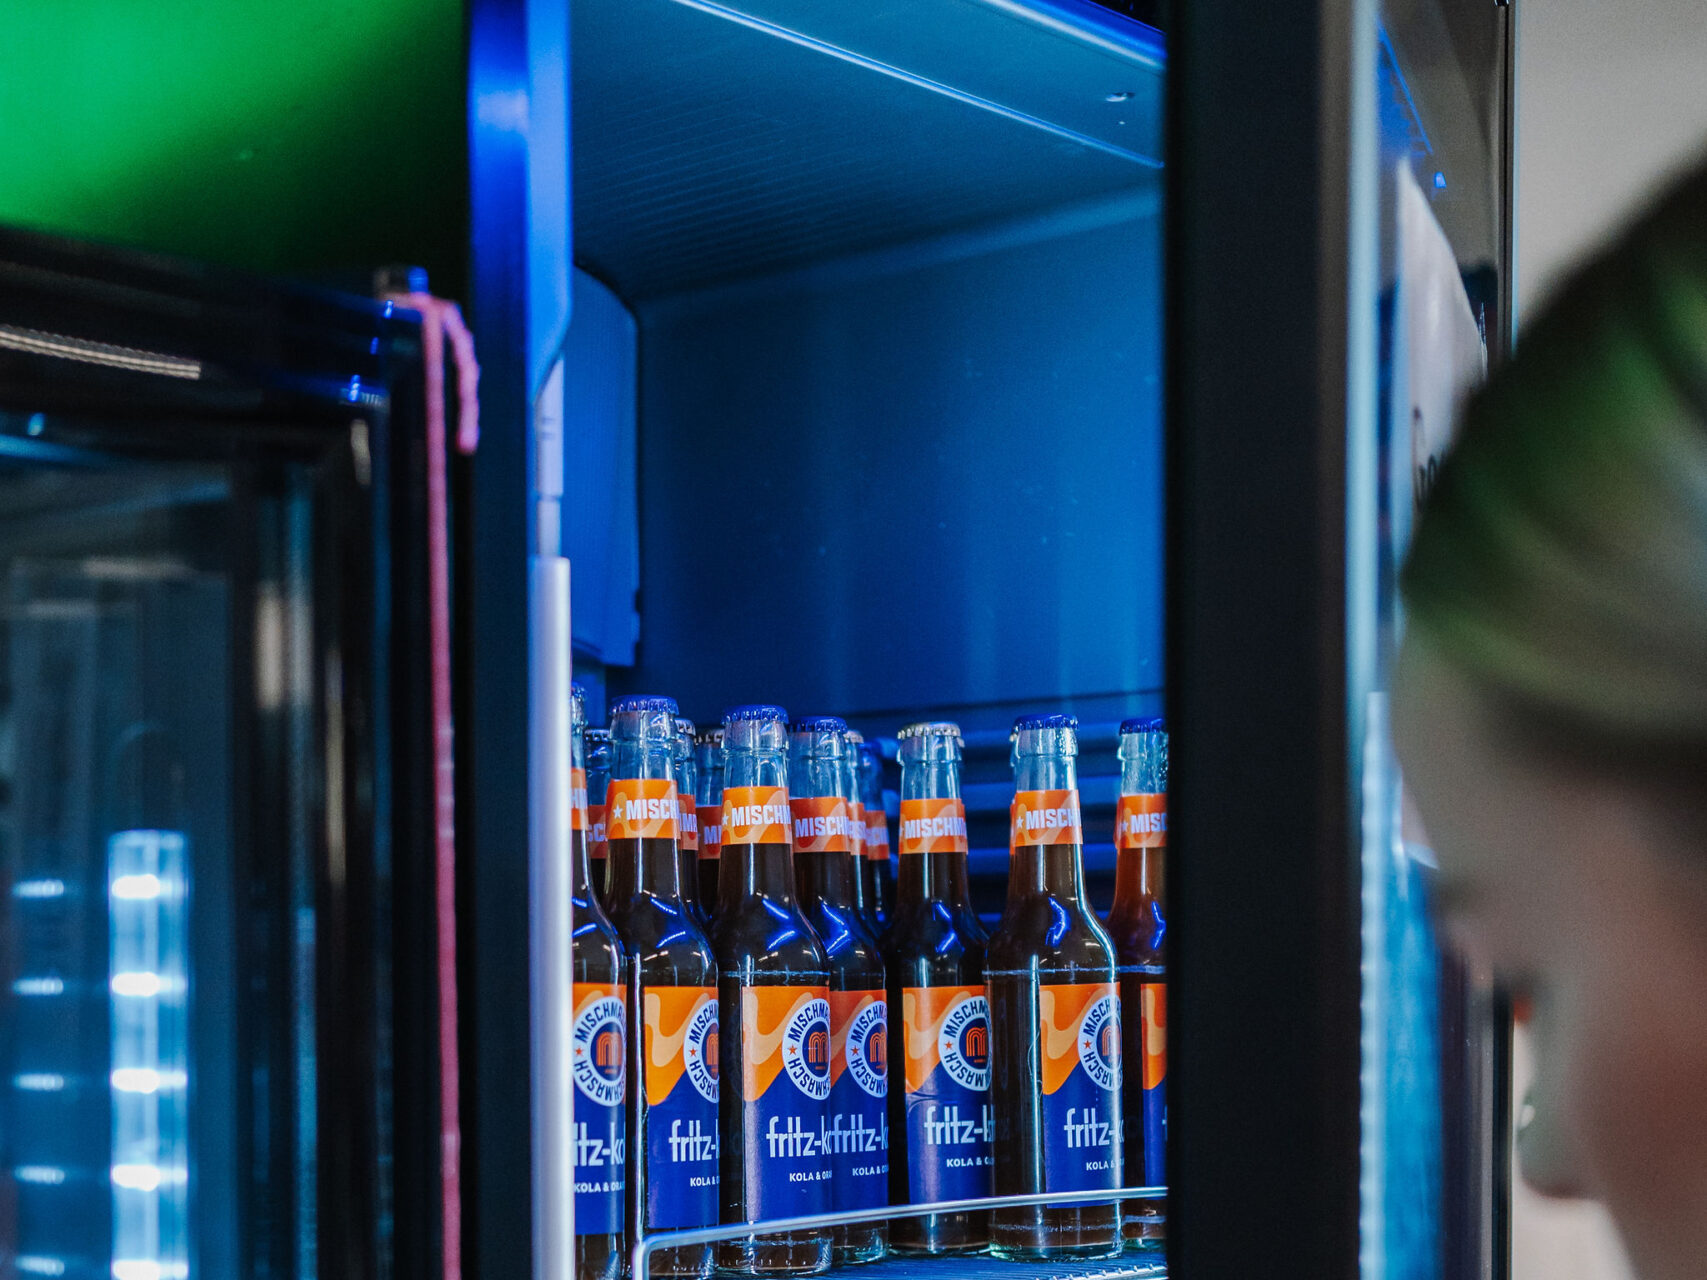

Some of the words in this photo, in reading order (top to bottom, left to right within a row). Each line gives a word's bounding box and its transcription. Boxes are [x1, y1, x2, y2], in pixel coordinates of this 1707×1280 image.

[947, 1157, 973, 1167] KOLA
[1086, 1159, 1109, 1171] KOLA
[852, 1166, 875, 1176] KOLA
[690, 1177, 711, 1187] KOLA
[789, 1173, 814, 1182] KOLA
